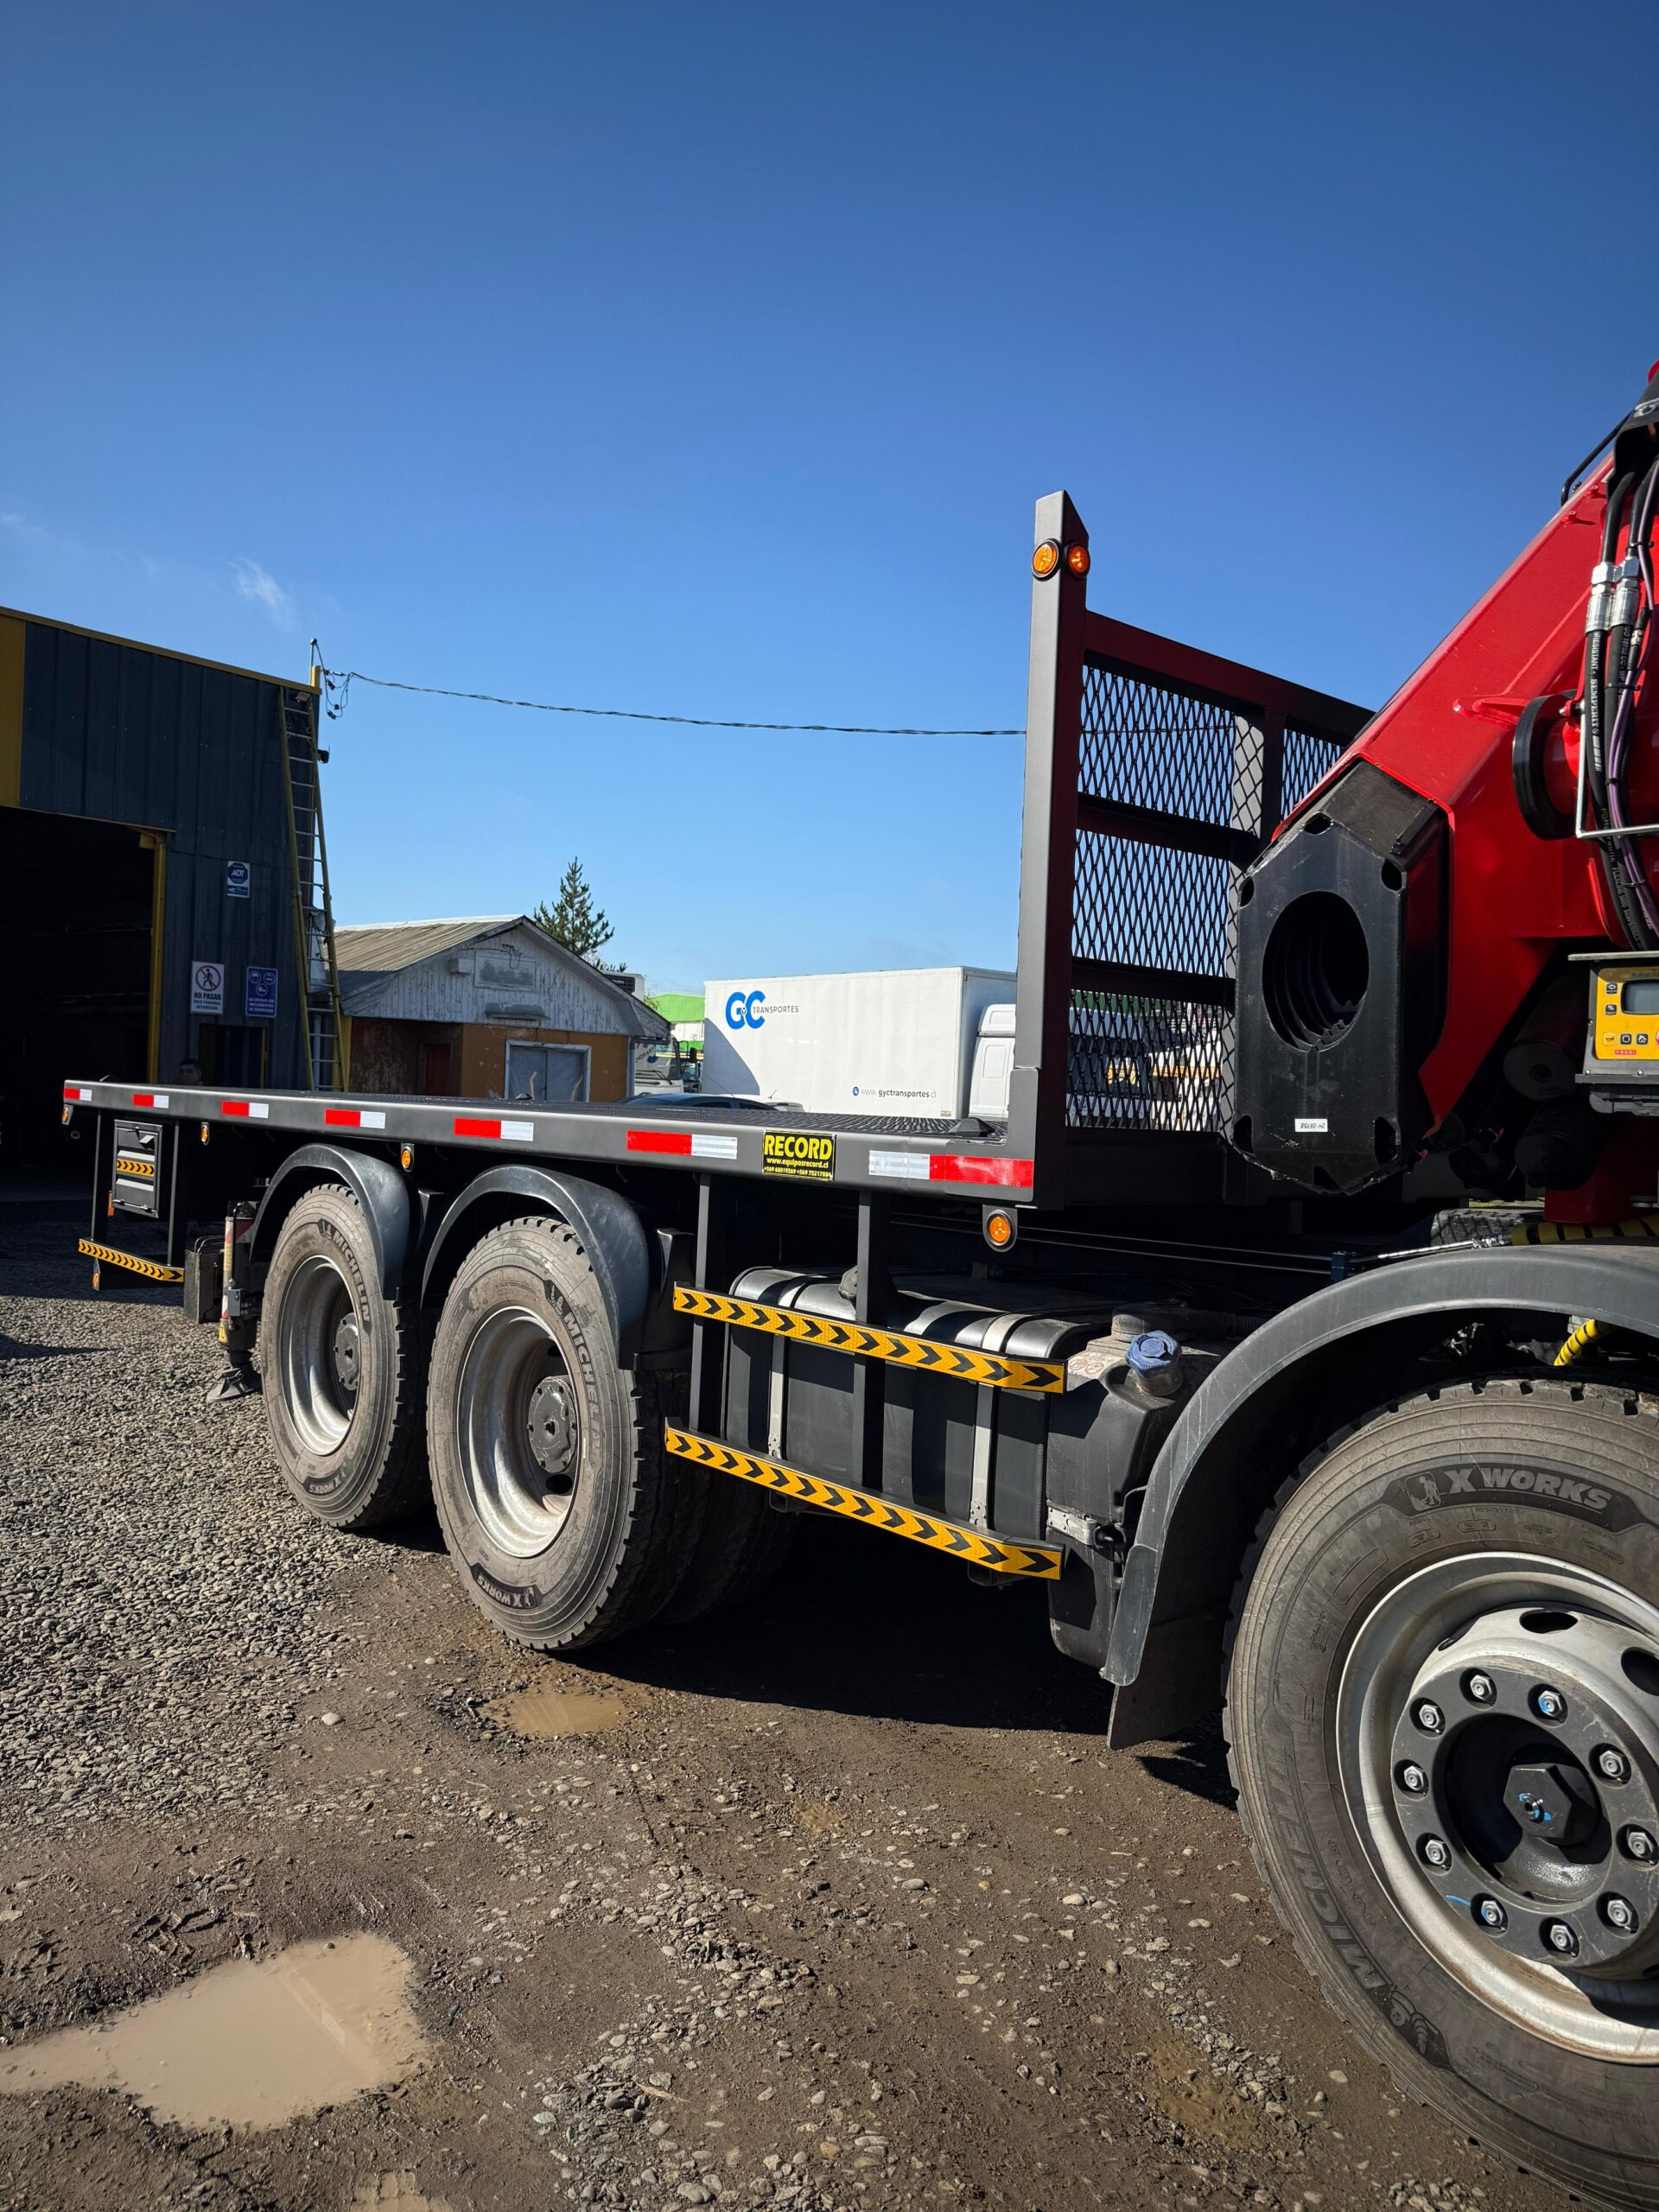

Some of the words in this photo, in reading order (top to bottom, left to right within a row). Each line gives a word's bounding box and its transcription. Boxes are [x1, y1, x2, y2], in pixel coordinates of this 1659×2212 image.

[1591, 678, 1599, 728] SEMPERIT
[753, 1005, 799, 1014] TRANSPORTES
[764, 1135, 832, 1160] RECORD
[333, 1230, 371, 1321] MICHELIN
[564, 1312, 602, 1456] MICHELIN
[309, 1481, 334, 1494] WORKS
[1444, 1469, 1478, 1494] X
[1481, 1468, 1611, 1510] WORKS
[477, 1574, 512, 1605] WORKS
[512, 1593, 523, 1607] X
